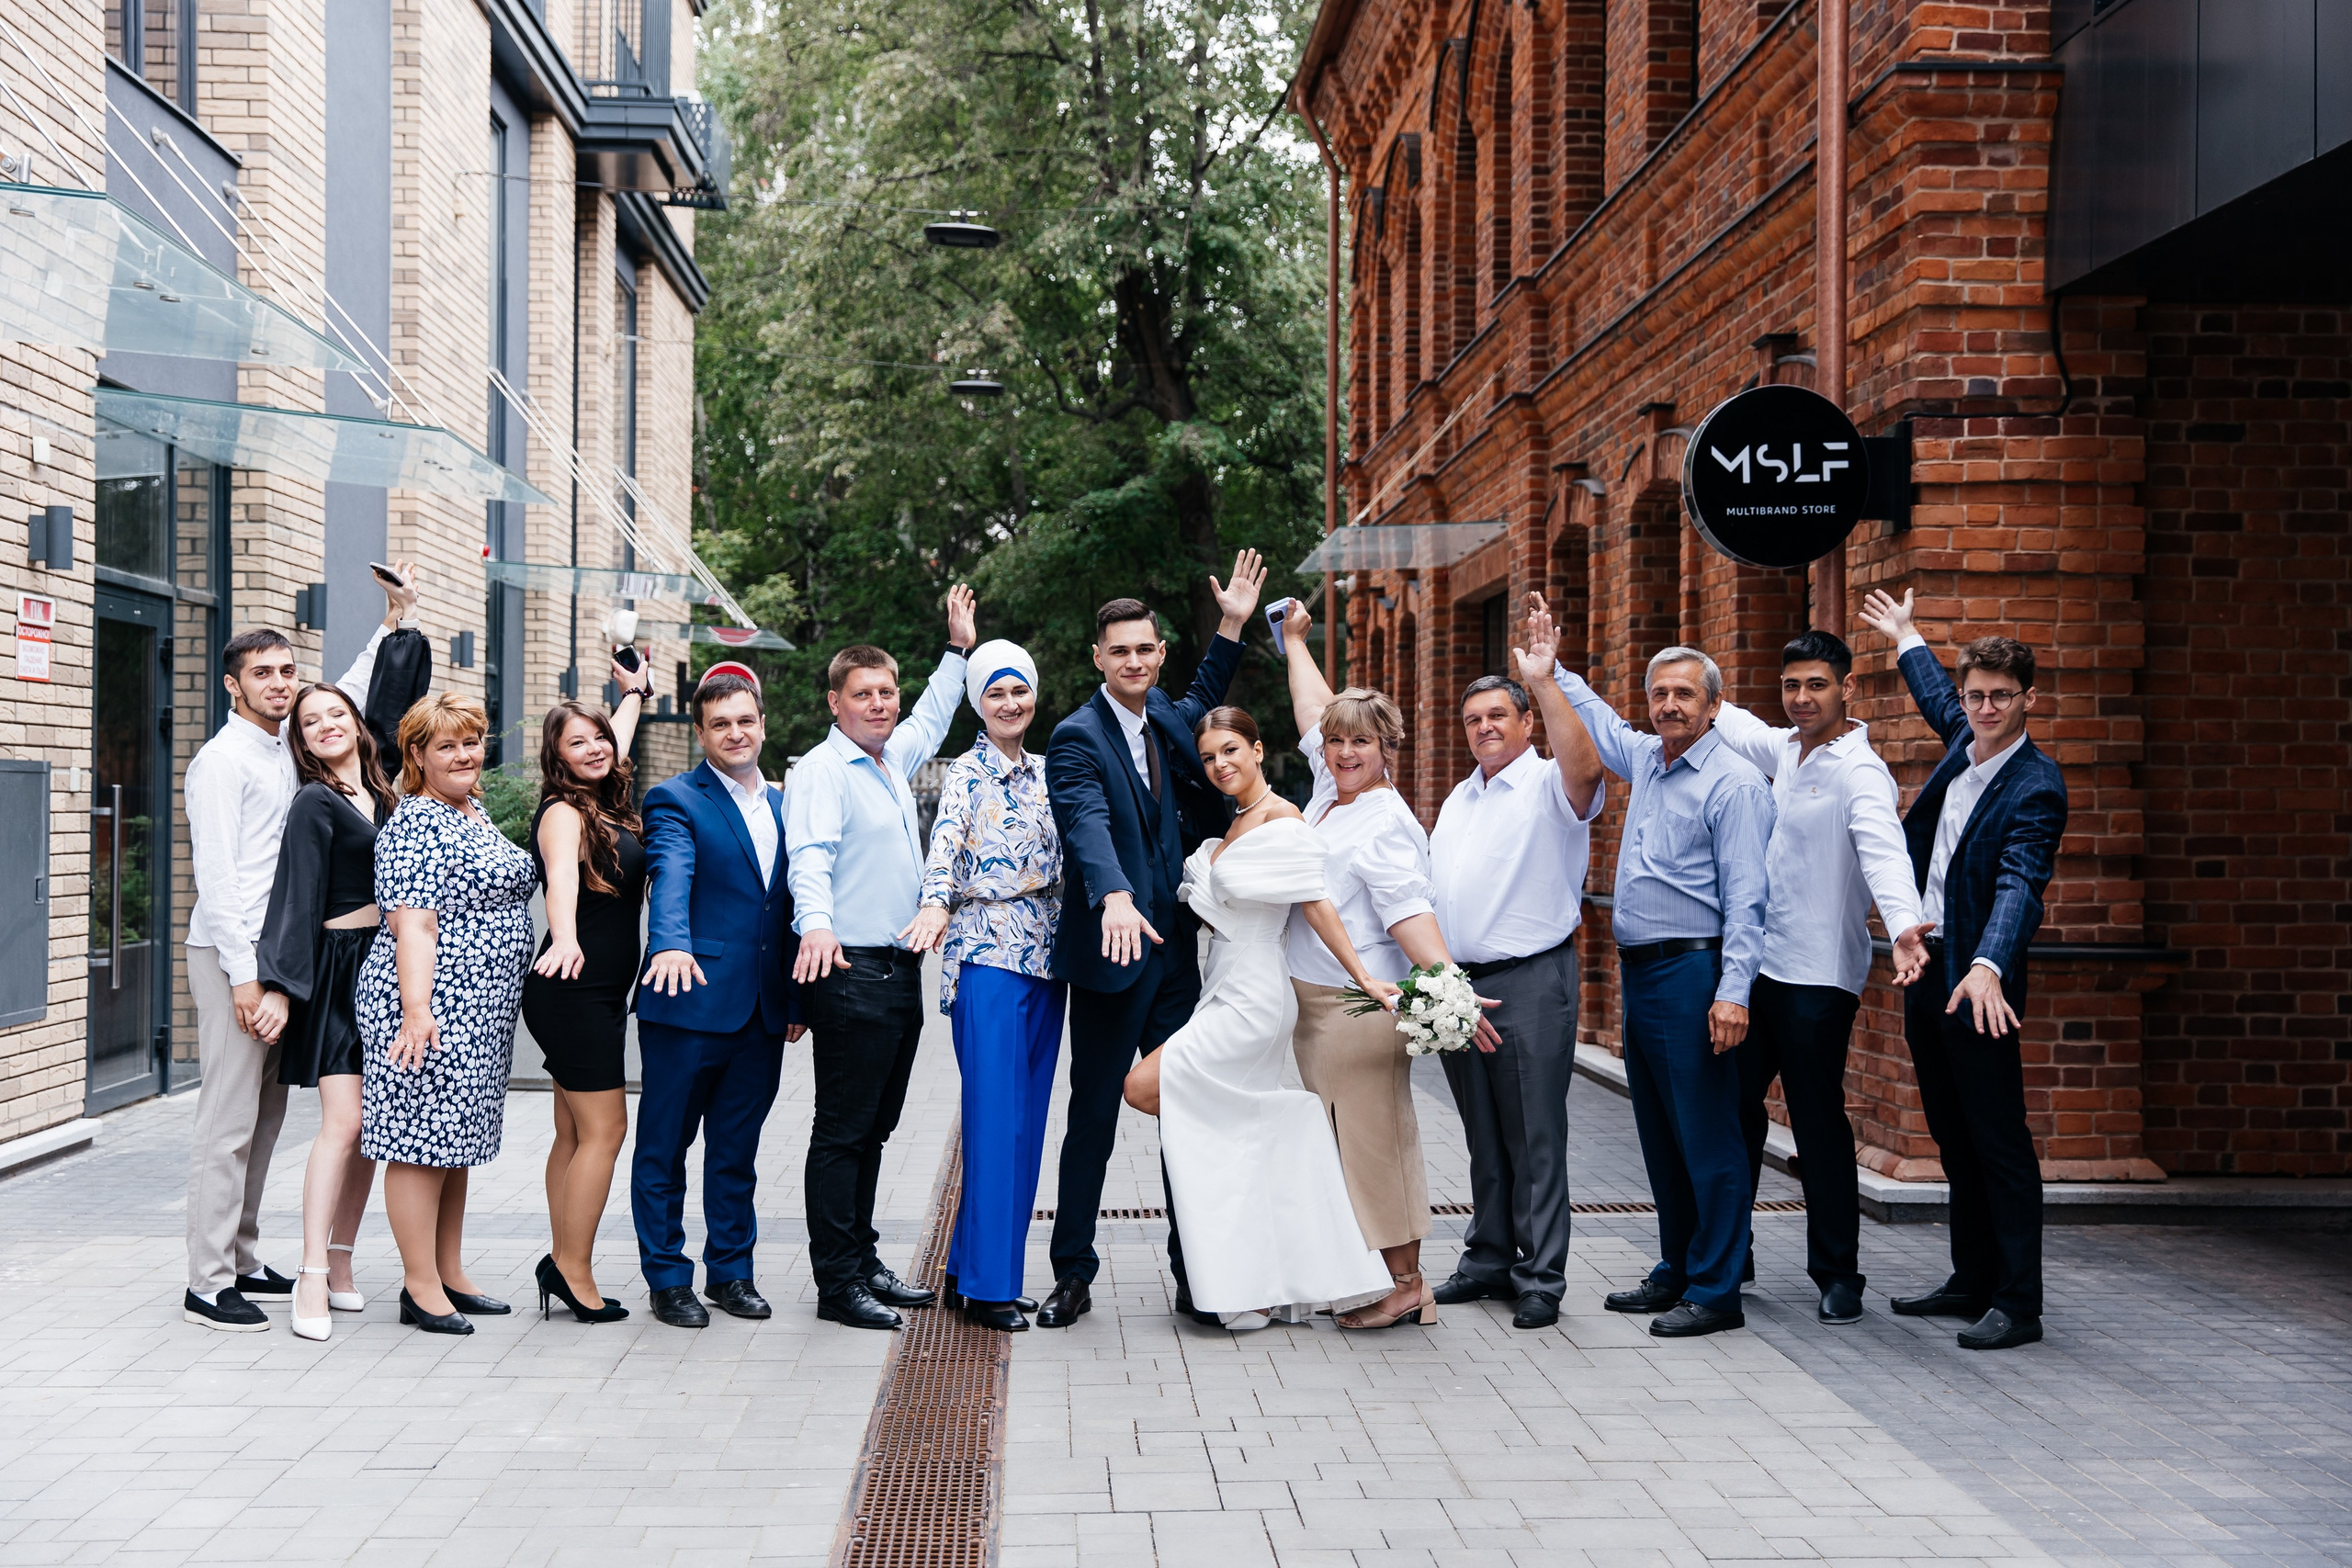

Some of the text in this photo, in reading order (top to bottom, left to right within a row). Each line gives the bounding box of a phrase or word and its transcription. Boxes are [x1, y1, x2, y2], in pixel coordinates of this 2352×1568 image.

[1711, 442, 1849, 484] MSLF
[1726, 504, 1837, 516] MULTIBRAND STORE
[30, 600, 44, 620] ПК
